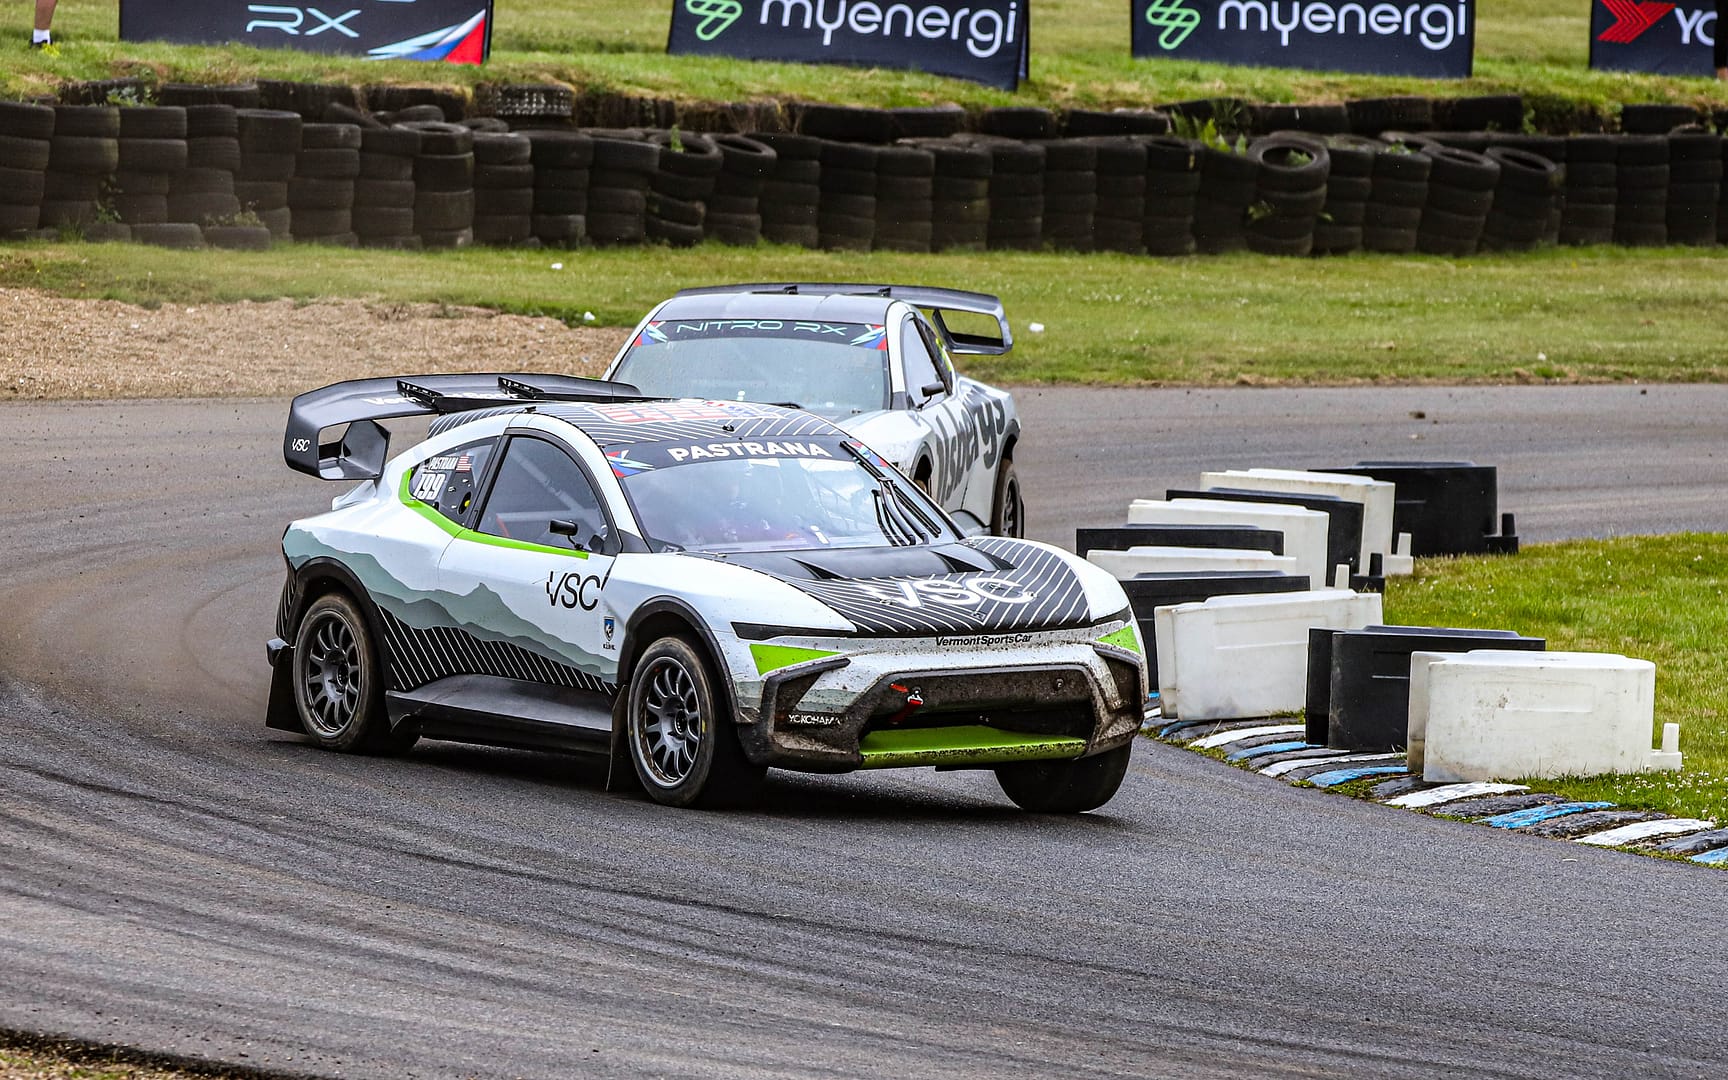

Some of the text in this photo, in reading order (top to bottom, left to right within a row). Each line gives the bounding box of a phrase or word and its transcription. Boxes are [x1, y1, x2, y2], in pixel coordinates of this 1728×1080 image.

[246, 4, 362, 38] RX
[759, 0, 1017, 58] myenergi
[1217, 0, 1466, 51] myenergi
[676, 320, 848, 336] NITRO RX
[292, 438, 310, 452] VSC
[667, 441, 832, 462] PASTRANA
[413, 473, 446, 500] 199
[546, 571, 601, 611] VSC
[851, 577, 1037, 608] VSC
[935, 633, 1033, 647] VermontSportsCar
